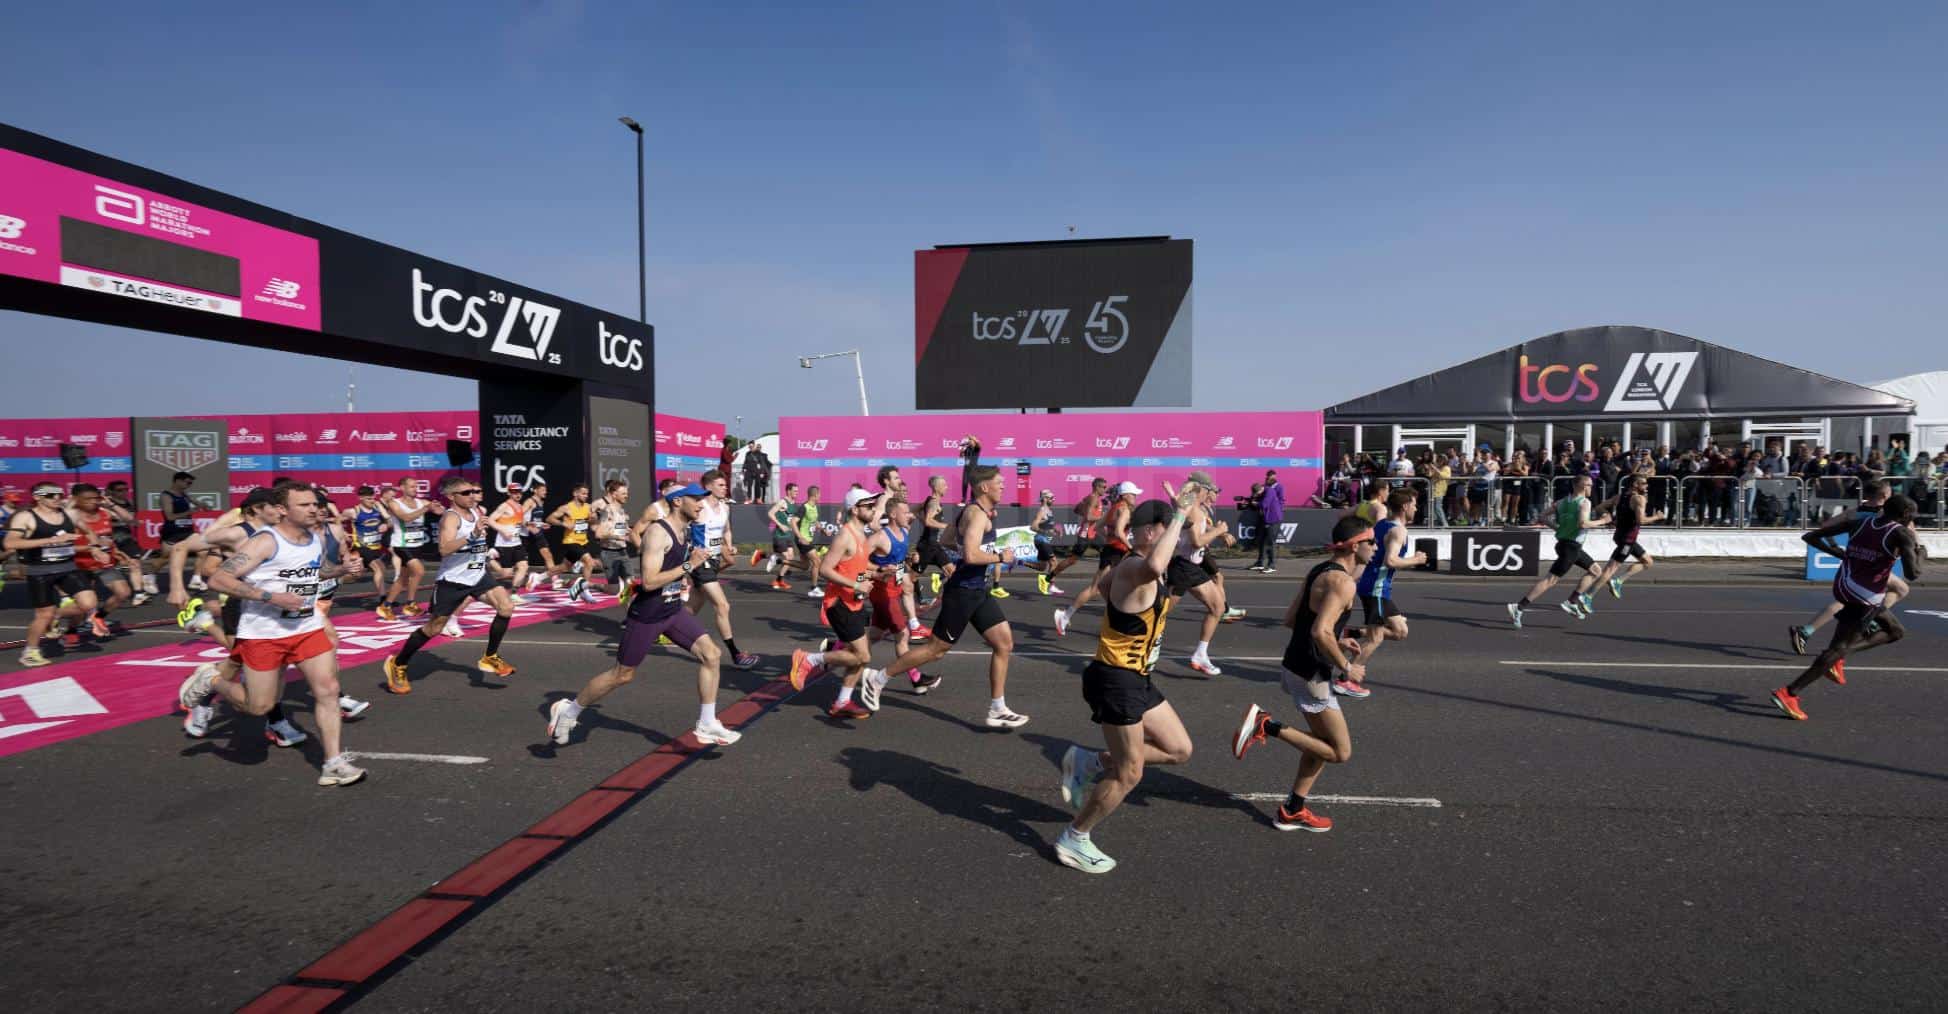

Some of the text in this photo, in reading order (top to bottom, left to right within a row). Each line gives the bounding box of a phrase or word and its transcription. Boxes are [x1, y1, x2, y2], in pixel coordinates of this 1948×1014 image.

[412, 268, 488, 338] tcs
[489, 290, 505, 304] 20
[548, 352, 561, 365] 25
[972, 311, 1017, 341] tcs
[599, 320, 643, 371] tcs
[1519, 354, 1600, 404] tcs
[493, 414, 526, 425] TATA
[152, 433, 212, 447] TAG
[494, 427, 569, 438] CONSULTANCY
[494, 440, 542, 451] SERVICES
[151, 450, 214, 470] HEUER
[1467, 537, 1524, 571] tcs
